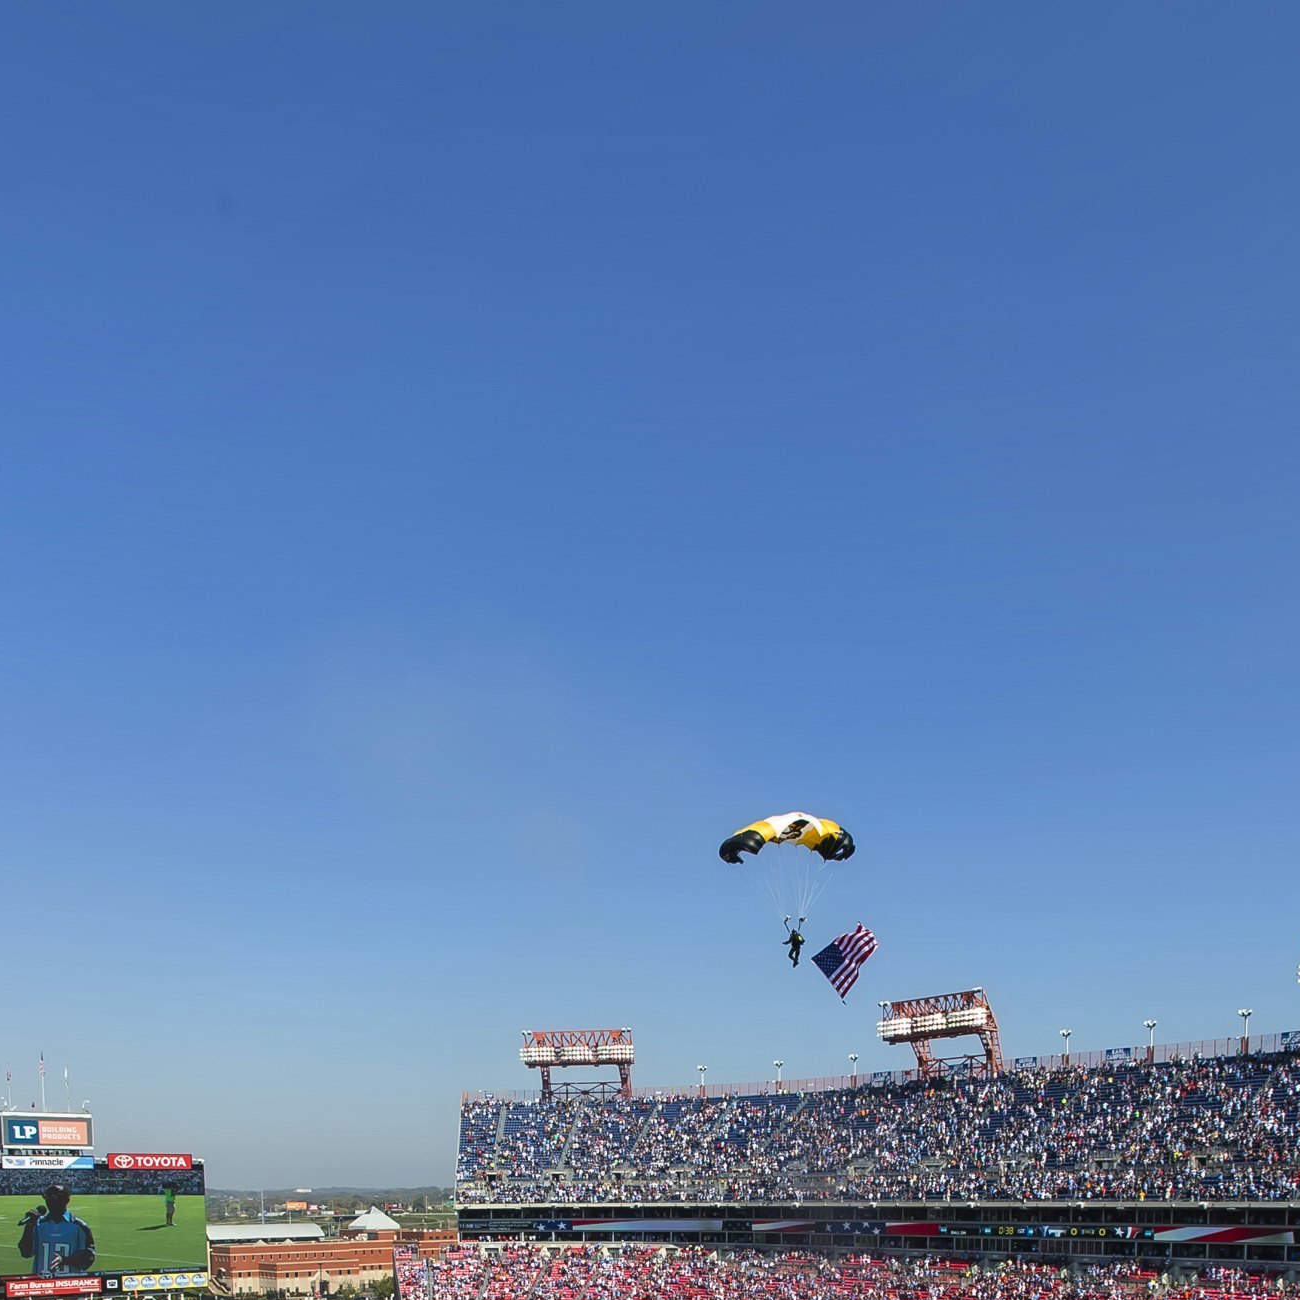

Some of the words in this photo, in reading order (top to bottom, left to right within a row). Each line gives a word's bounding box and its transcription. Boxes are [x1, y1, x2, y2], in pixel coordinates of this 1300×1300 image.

[12, 1126, 37, 1139] LP
[30, 1158, 64, 1166] Pinnacle
[135, 1156, 187, 1167] TOYOTA
[1070, 1228, 1078, 1236] 0
[1099, 1228, 1106, 1236] 0
[10, 1282, 28, 1290] Farm
[30, 1281, 54, 1289] Bureau
[56, 1279, 99, 1288] INSURANCE
